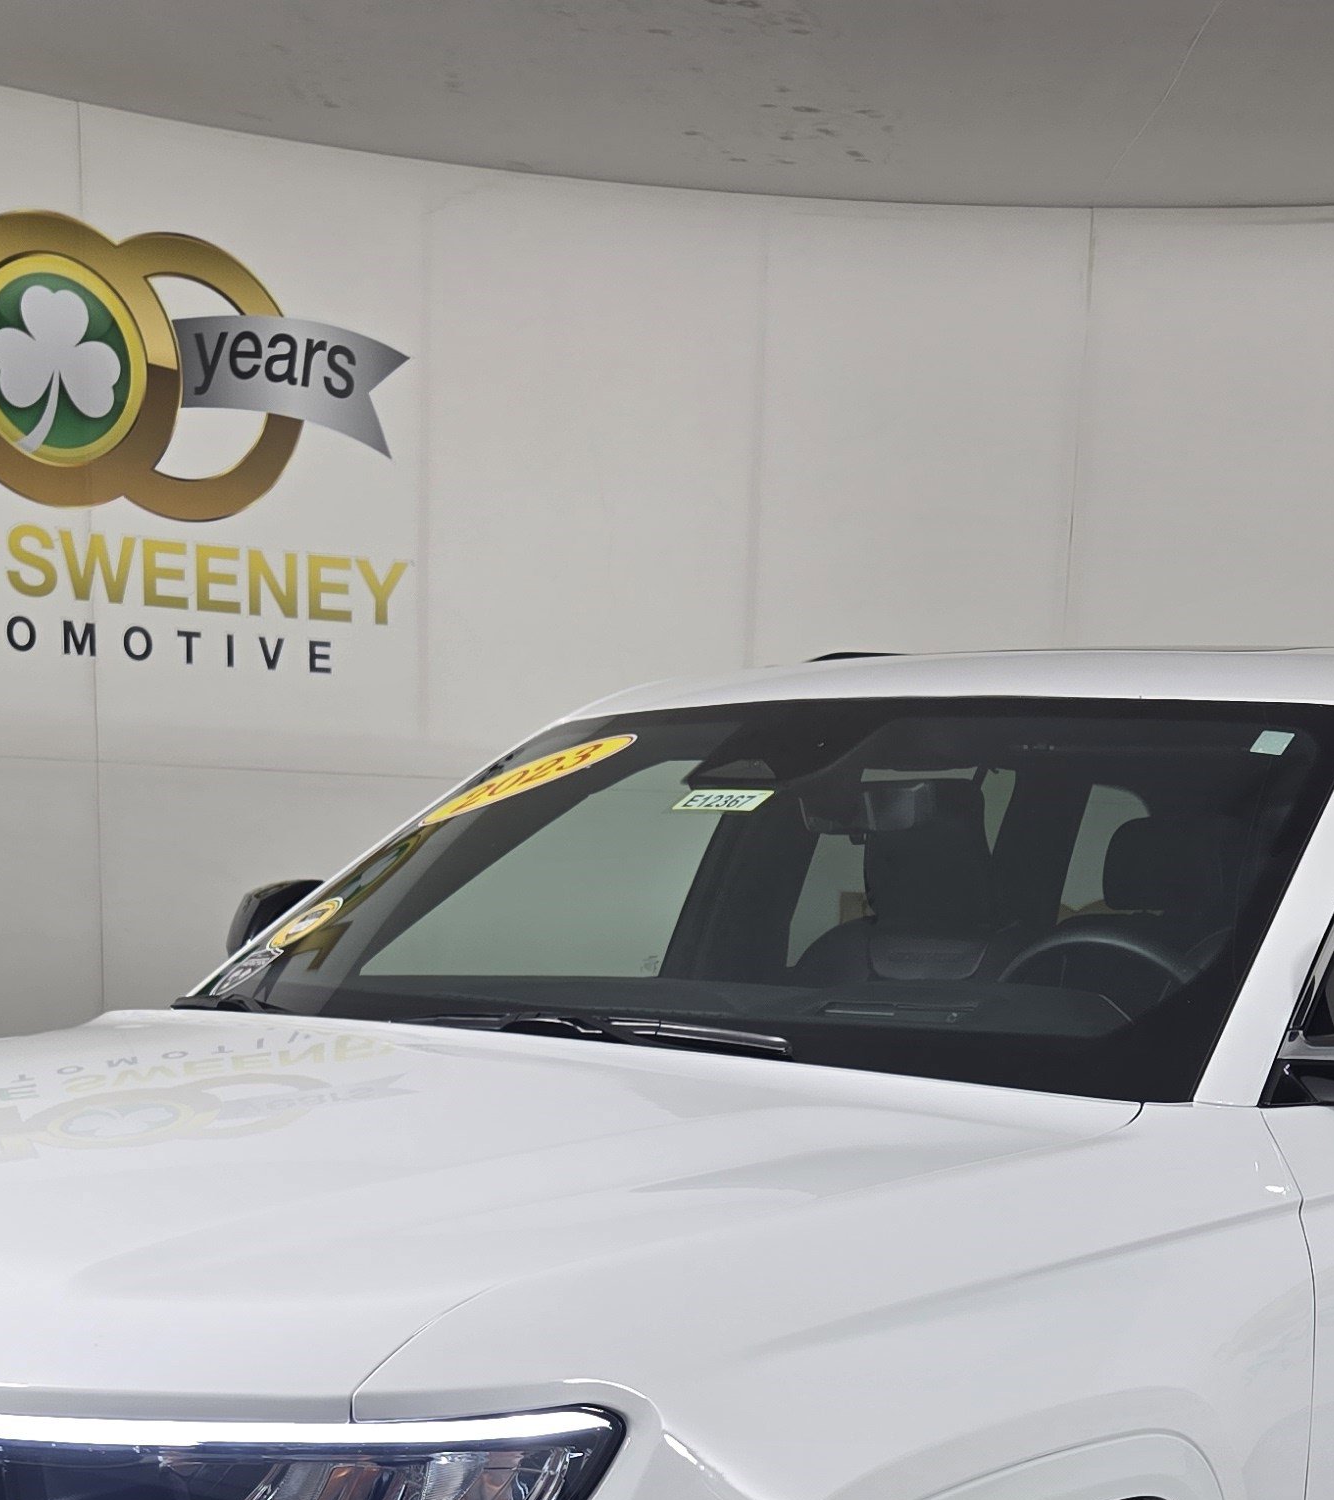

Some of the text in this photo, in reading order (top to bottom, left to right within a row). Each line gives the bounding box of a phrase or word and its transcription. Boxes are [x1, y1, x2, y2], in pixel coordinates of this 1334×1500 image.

[192, 327, 357, 399] years
[5, 523, 408, 626] SWEENEY
[449, 743, 604, 814] 2023
[682, 794, 756, 810] E12367
